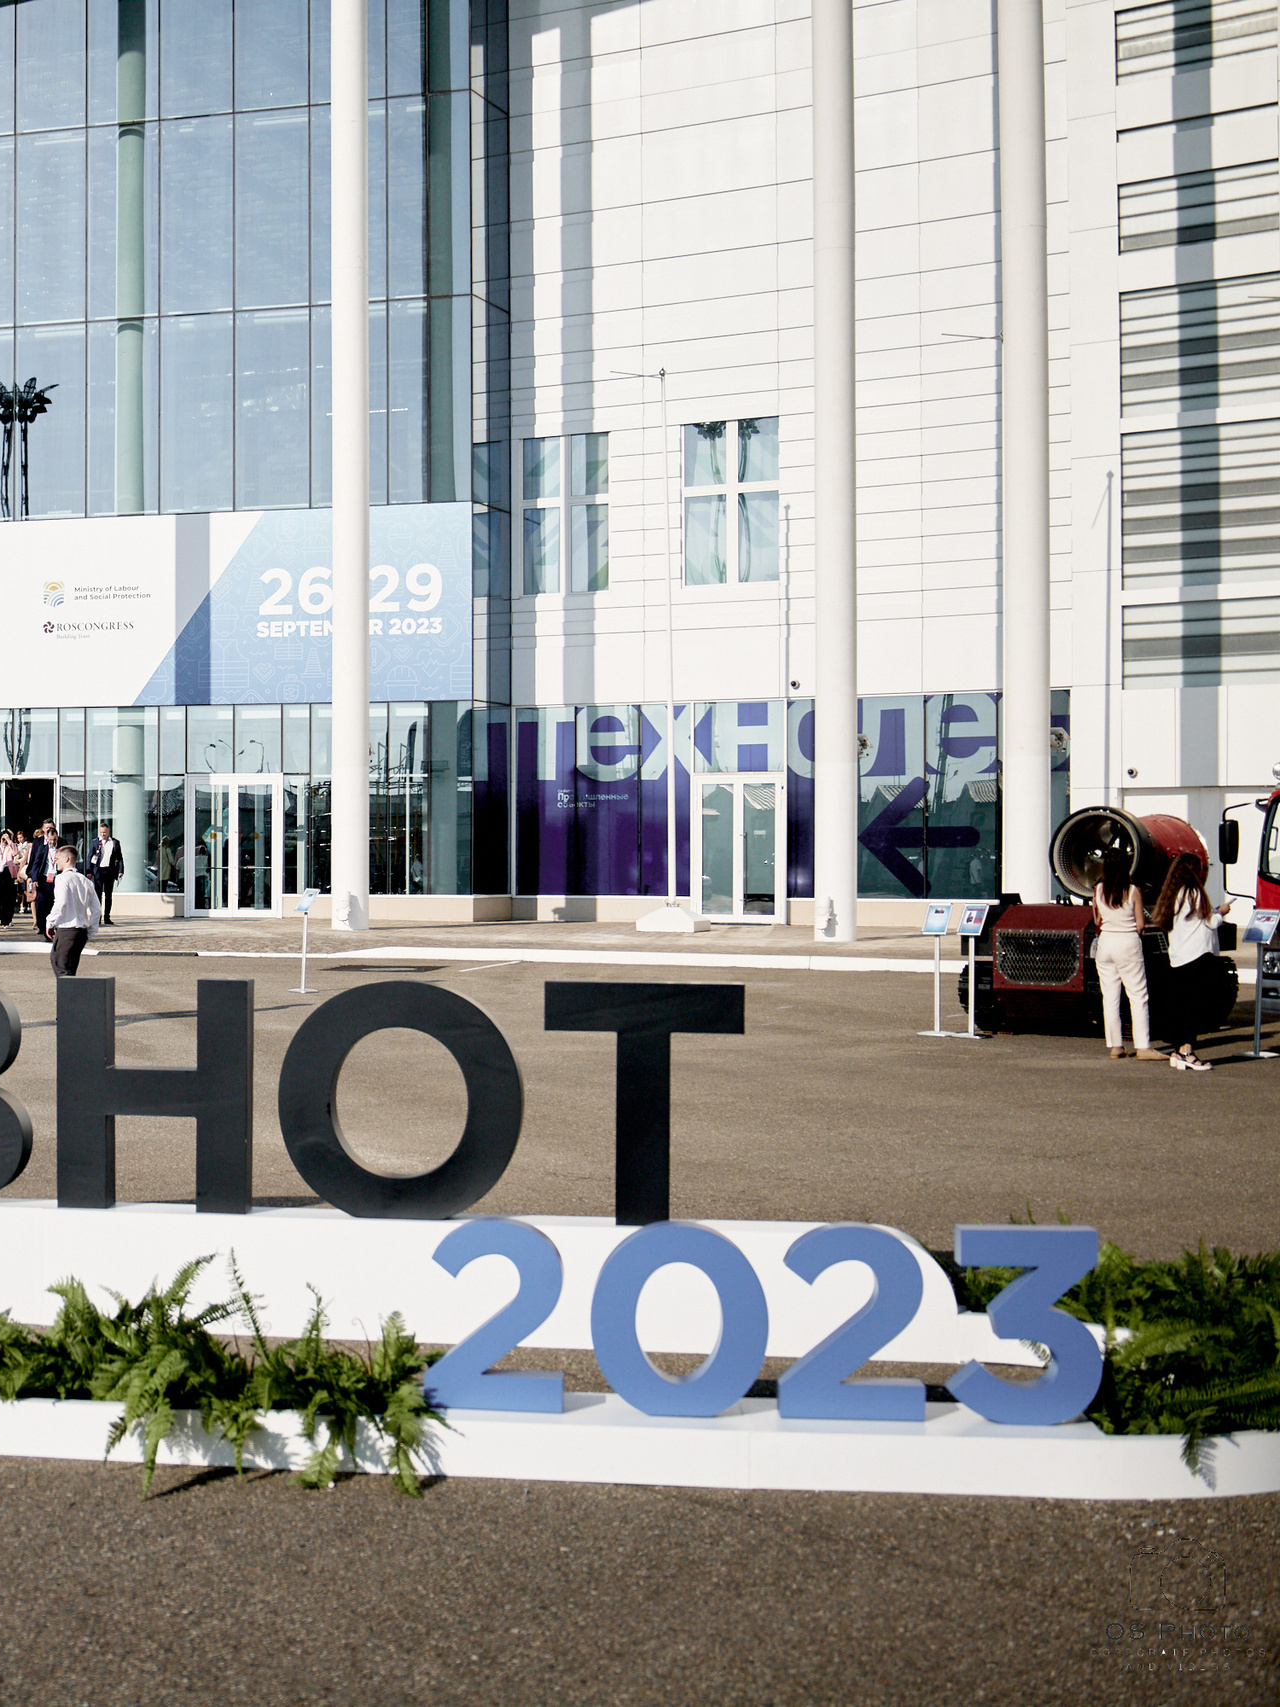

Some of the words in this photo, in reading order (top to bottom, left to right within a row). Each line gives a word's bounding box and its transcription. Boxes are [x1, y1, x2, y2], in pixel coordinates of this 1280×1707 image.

[74, 585, 103, 593] Ministry
[112, 592, 151, 600] Protection
[56, 621, 134, 632] ROSCONGRESS
[256, 619, 383, 638] SEPTER
[388, 617, 442, 635] 2023
[423, 1216, 1103, 1425] 2023
